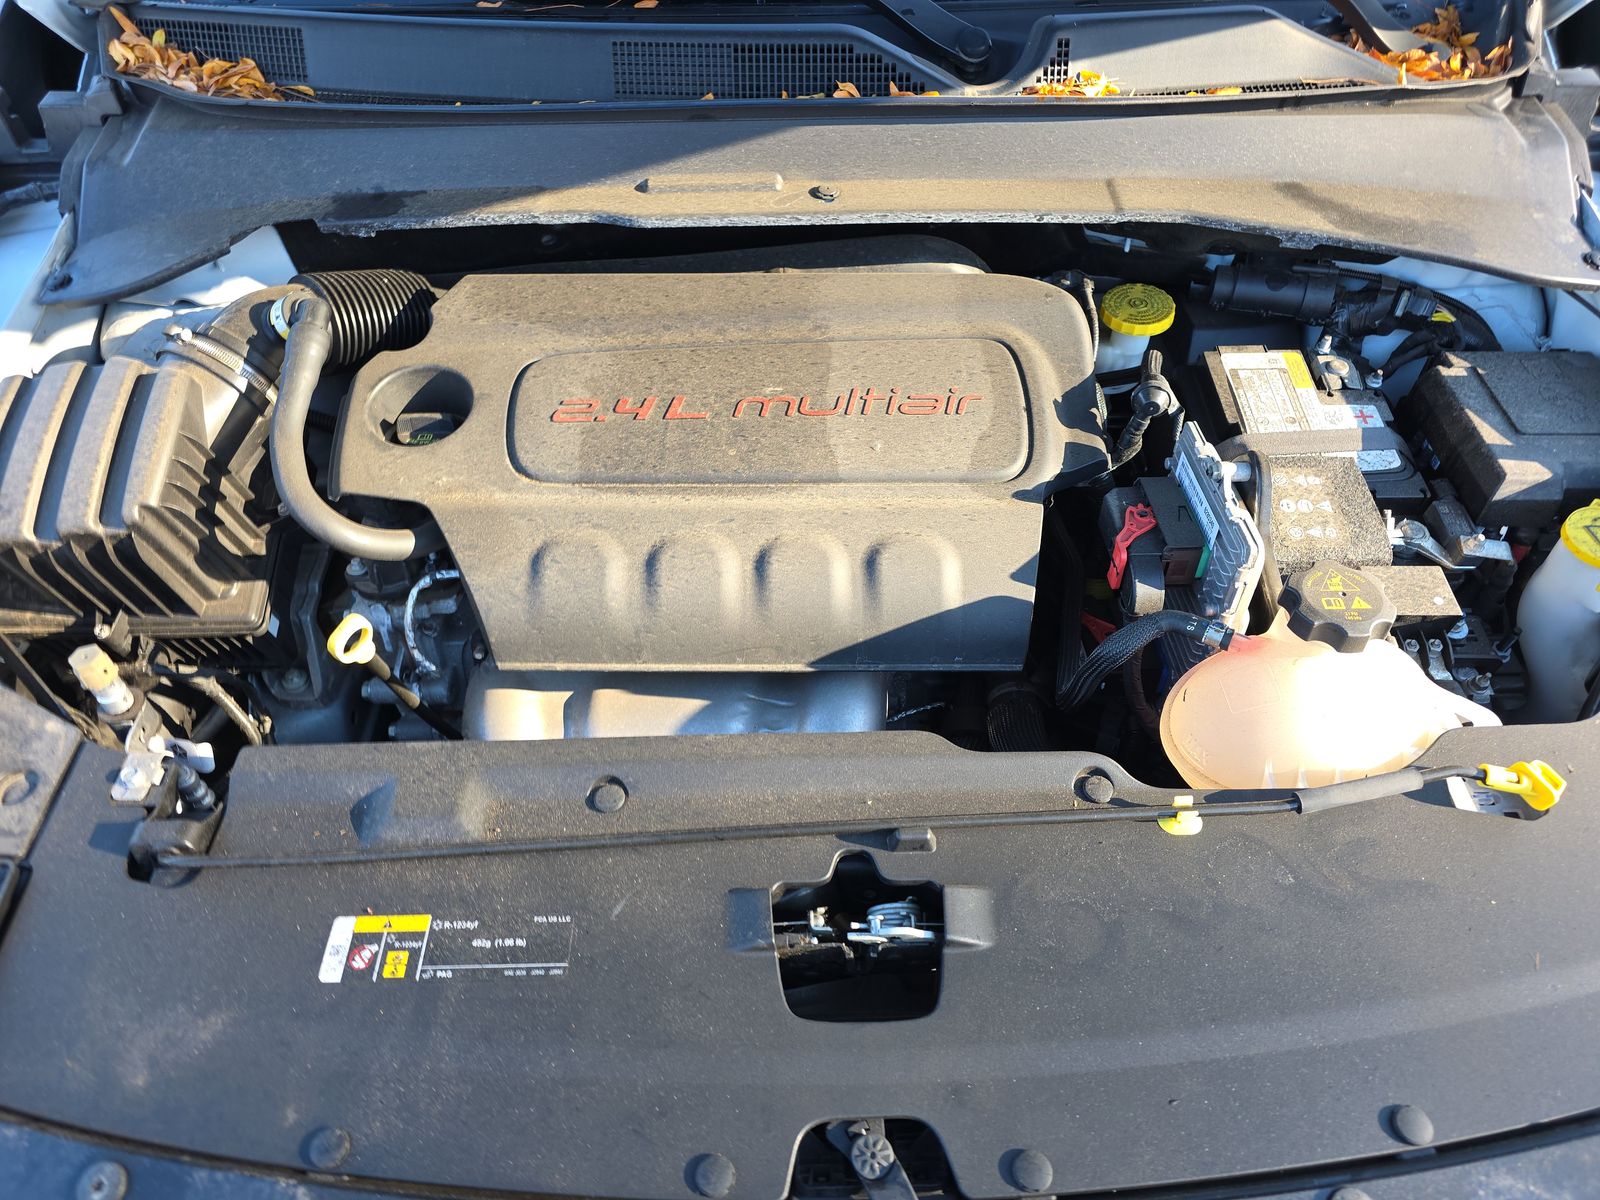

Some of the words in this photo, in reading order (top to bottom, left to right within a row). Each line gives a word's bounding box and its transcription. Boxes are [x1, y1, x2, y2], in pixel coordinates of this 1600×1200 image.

[732, 386, 984, 418] multiair
[443, 919, 479, 931] R-1234yf
[533, 915, 547, 923] FCA
[558, 915, 571, 923] LLC
